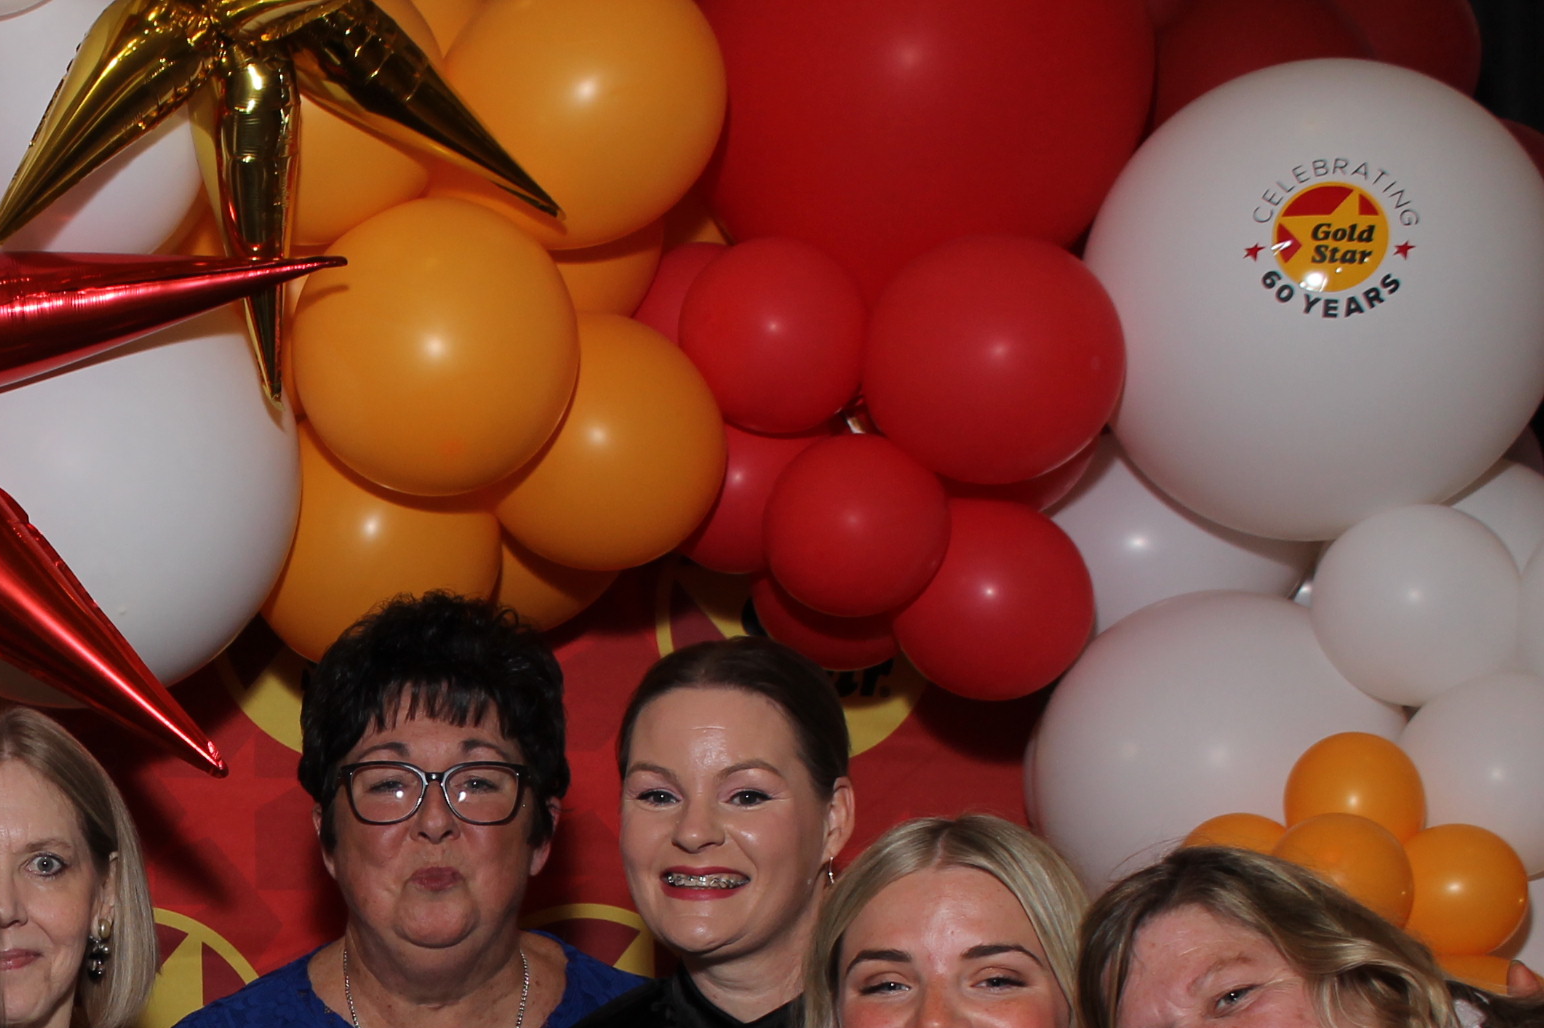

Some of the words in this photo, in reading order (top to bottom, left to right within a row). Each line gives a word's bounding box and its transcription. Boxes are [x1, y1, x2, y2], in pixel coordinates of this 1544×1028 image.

[1252, 157, 1420, 228] CELEBRATING
[1311, 222, 1376, 243] Gold
[1311, 244, 1373, 265] Star
[1261, 270, 1295, 304] 60
[1302, 273, 1401, 318] YEARS
